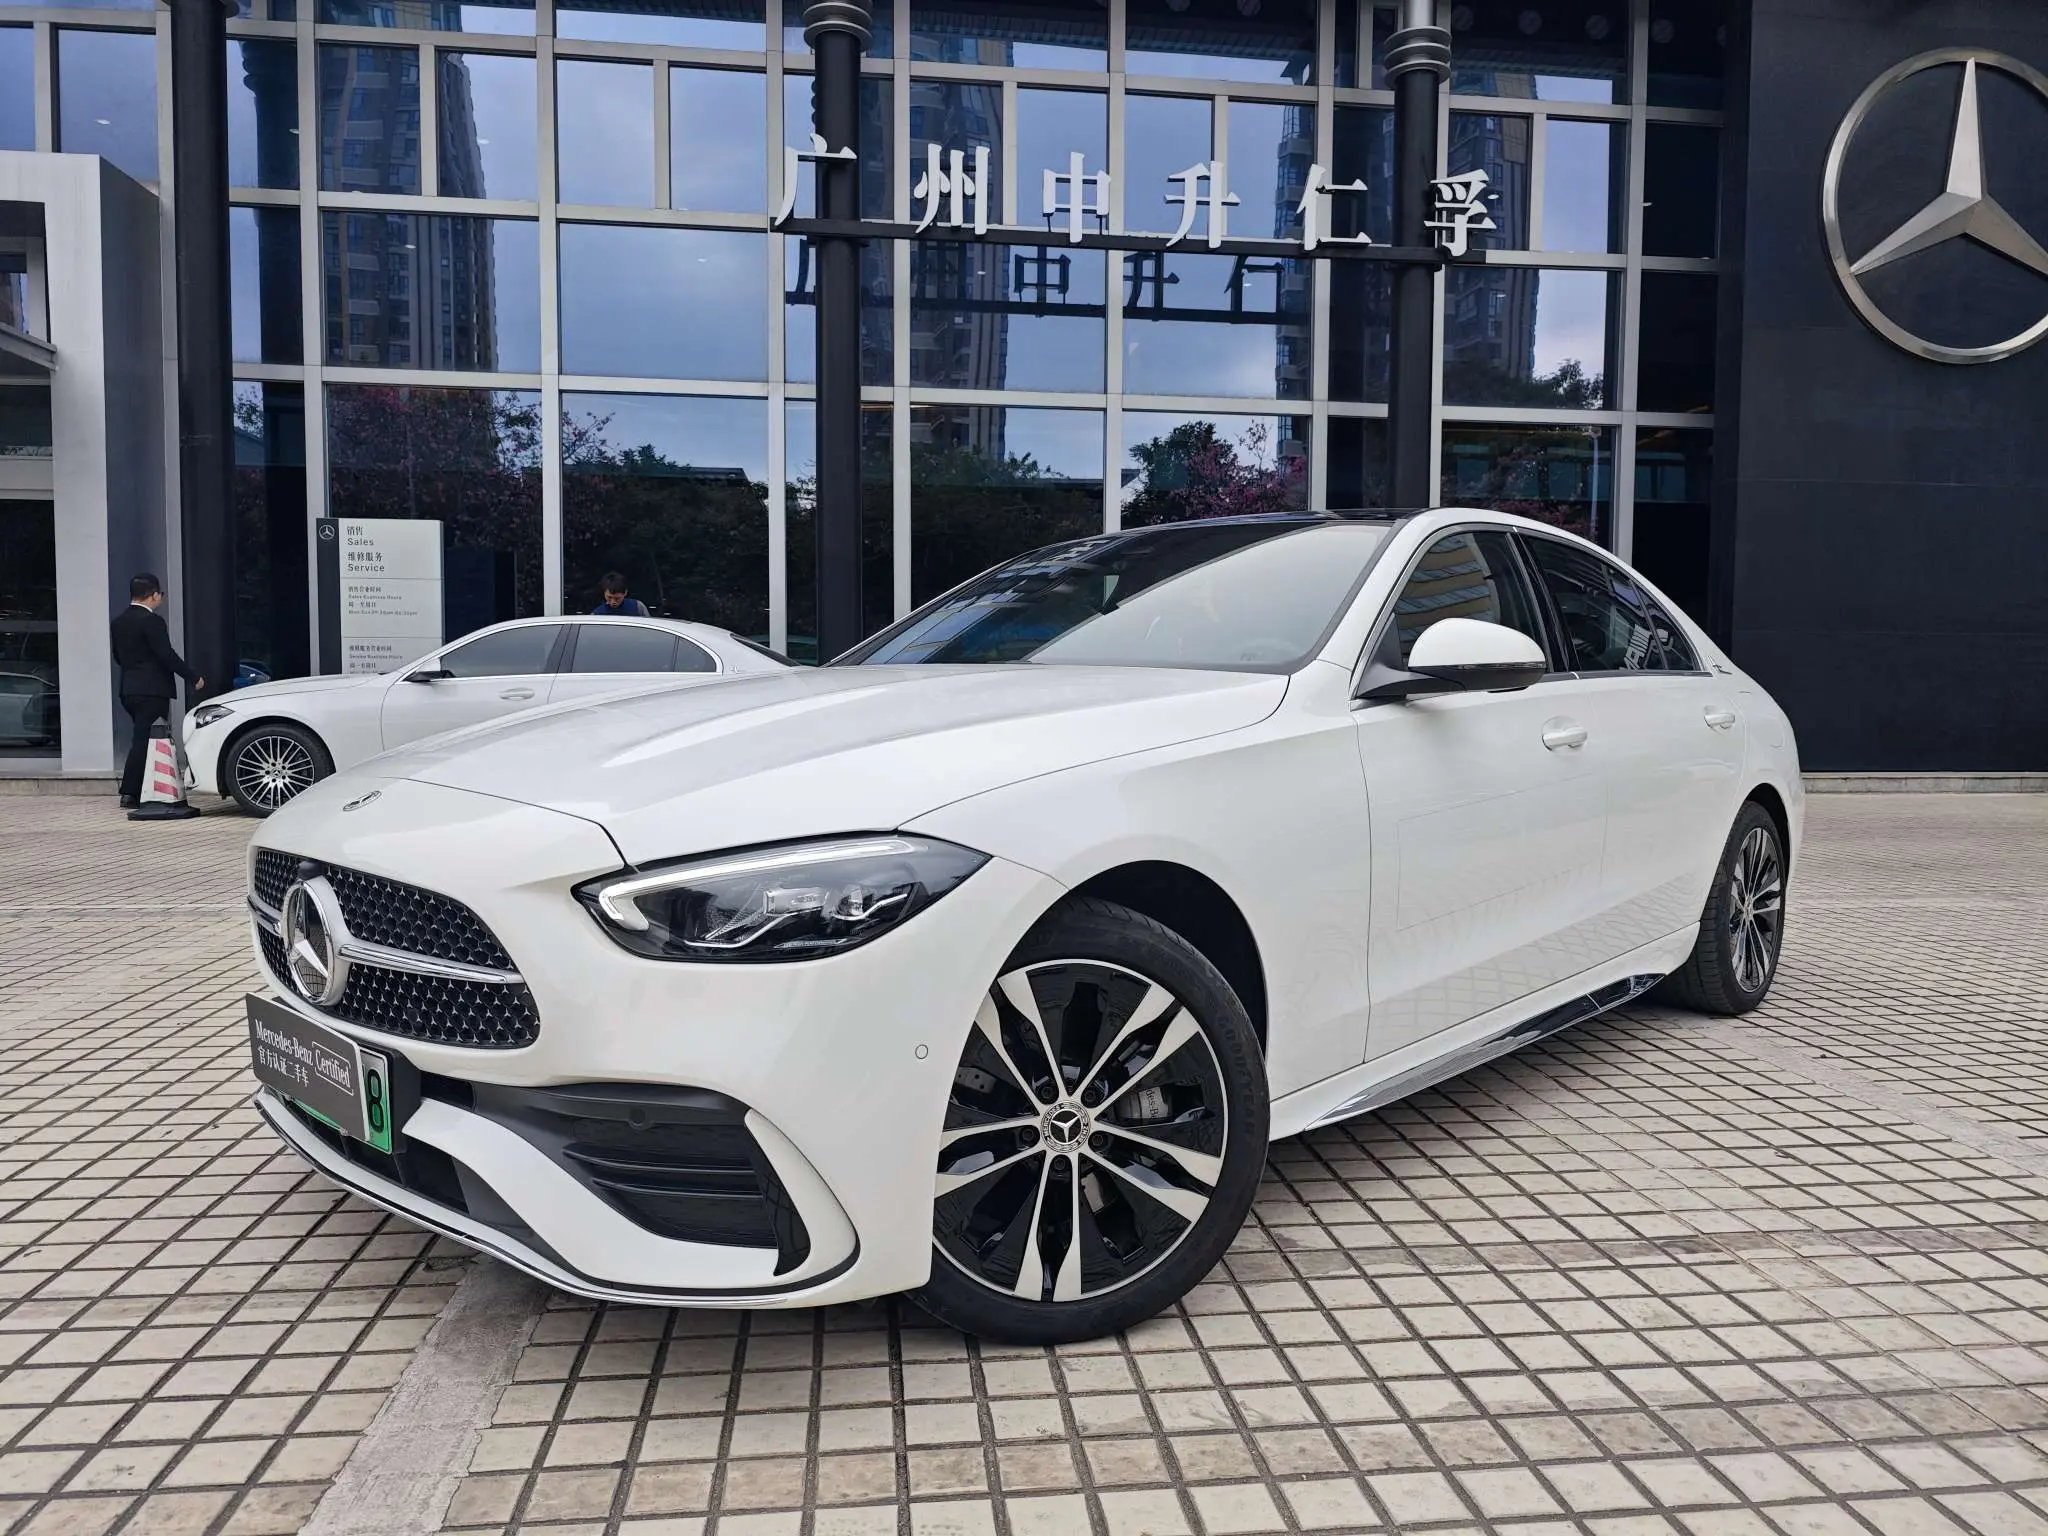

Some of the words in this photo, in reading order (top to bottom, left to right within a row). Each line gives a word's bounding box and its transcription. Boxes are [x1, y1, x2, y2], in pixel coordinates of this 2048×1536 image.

[774, 133, 1497, 257] 广州中升仁孚
[347, 525, 363, 536] 销售
[347, 538, 374, 546] Sales
[347, 551, 383, 562] 维修服务
[347, 563, 385, 572] Service
[254, 1018, 314, 1066] Mercedes-Benz
[315, 1049, 351, 1088] Certified
[258, 1046, 309, 1087] 官方认证二手车
[367, 1068, 385, 1134] 8
